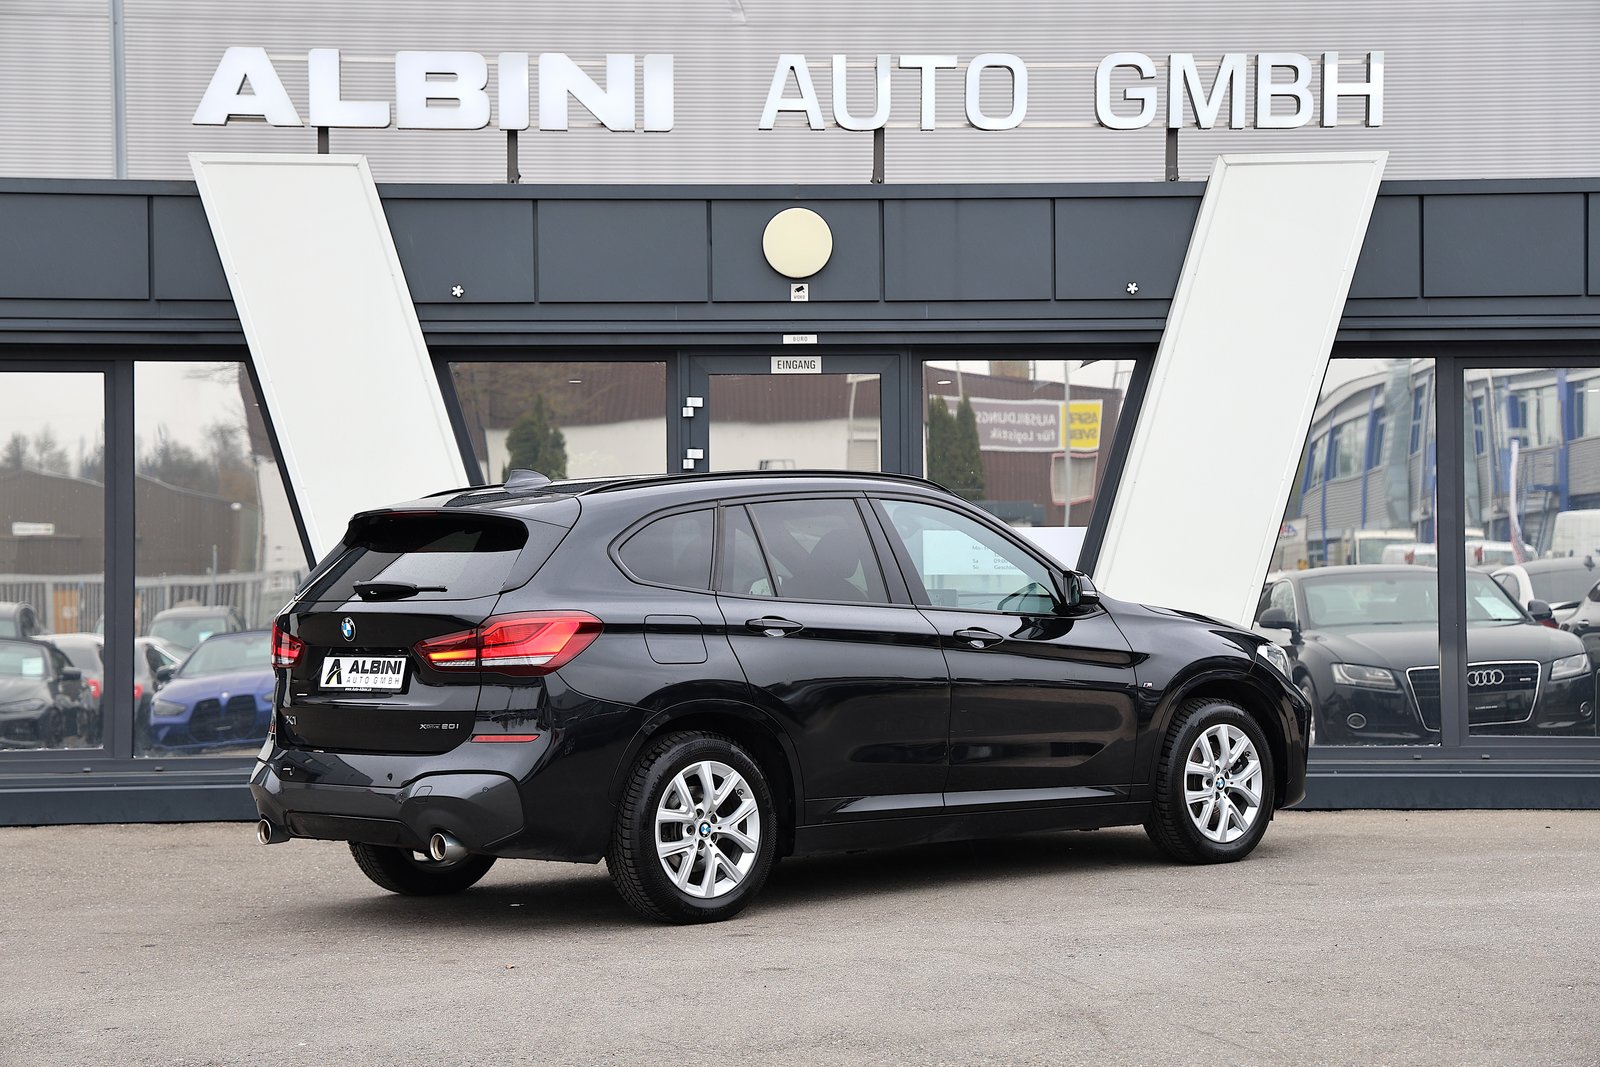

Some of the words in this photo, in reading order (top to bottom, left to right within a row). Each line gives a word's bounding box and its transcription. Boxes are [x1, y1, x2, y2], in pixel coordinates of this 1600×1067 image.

[192, 46, 675, 133] ALBINI
[758, 52, 1028, 131] AUTO
[1094, 50, 1385, 130] GMBH
[777, 360, 816, 369] EINGANG
[348, 660, 402, 674] ALBINI
[346, 676, 370, 684] AUTO
[373, 676, 400, 685] GMBH
[285, 715, 297, 726] X1
